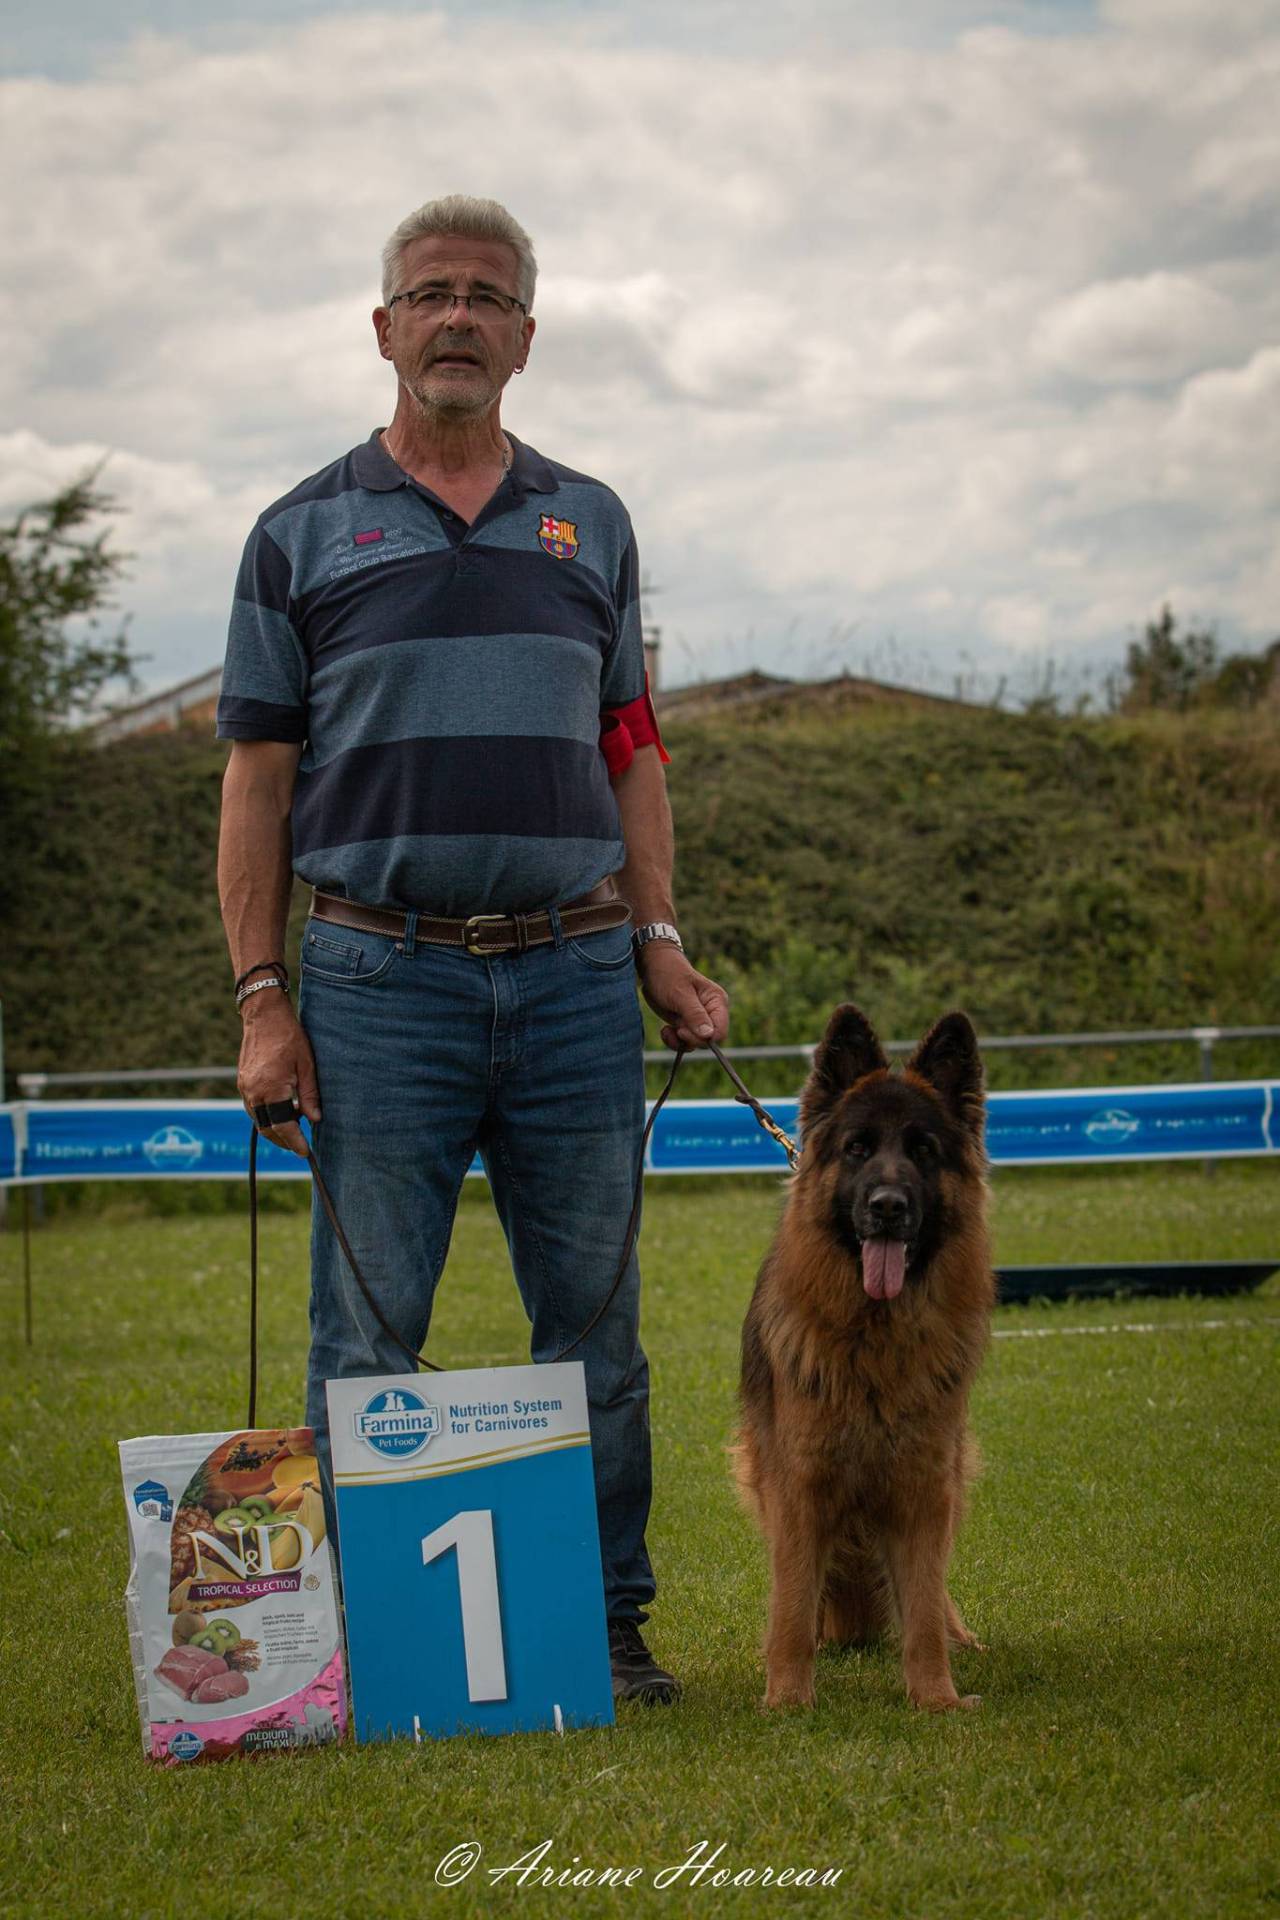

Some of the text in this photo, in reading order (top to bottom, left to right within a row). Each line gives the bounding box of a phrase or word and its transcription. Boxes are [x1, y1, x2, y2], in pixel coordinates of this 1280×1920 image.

[358, 556, 380, 569] Club
[381, 546, 426, 562] Barcelona
[449, 1399, 562, 1418] Nutrition System
[360, 1412, 433, 1434] Farmina
[451, 1416, 548, 1433] for Carnivores
[379, 1437, 418, 1448] Pet Foods
[187, 1521, 313, 1580] N&D
[197, 1580, 298, 1596] TROPICAL SELECTION
[421, 1509, 507, 1702] 1
